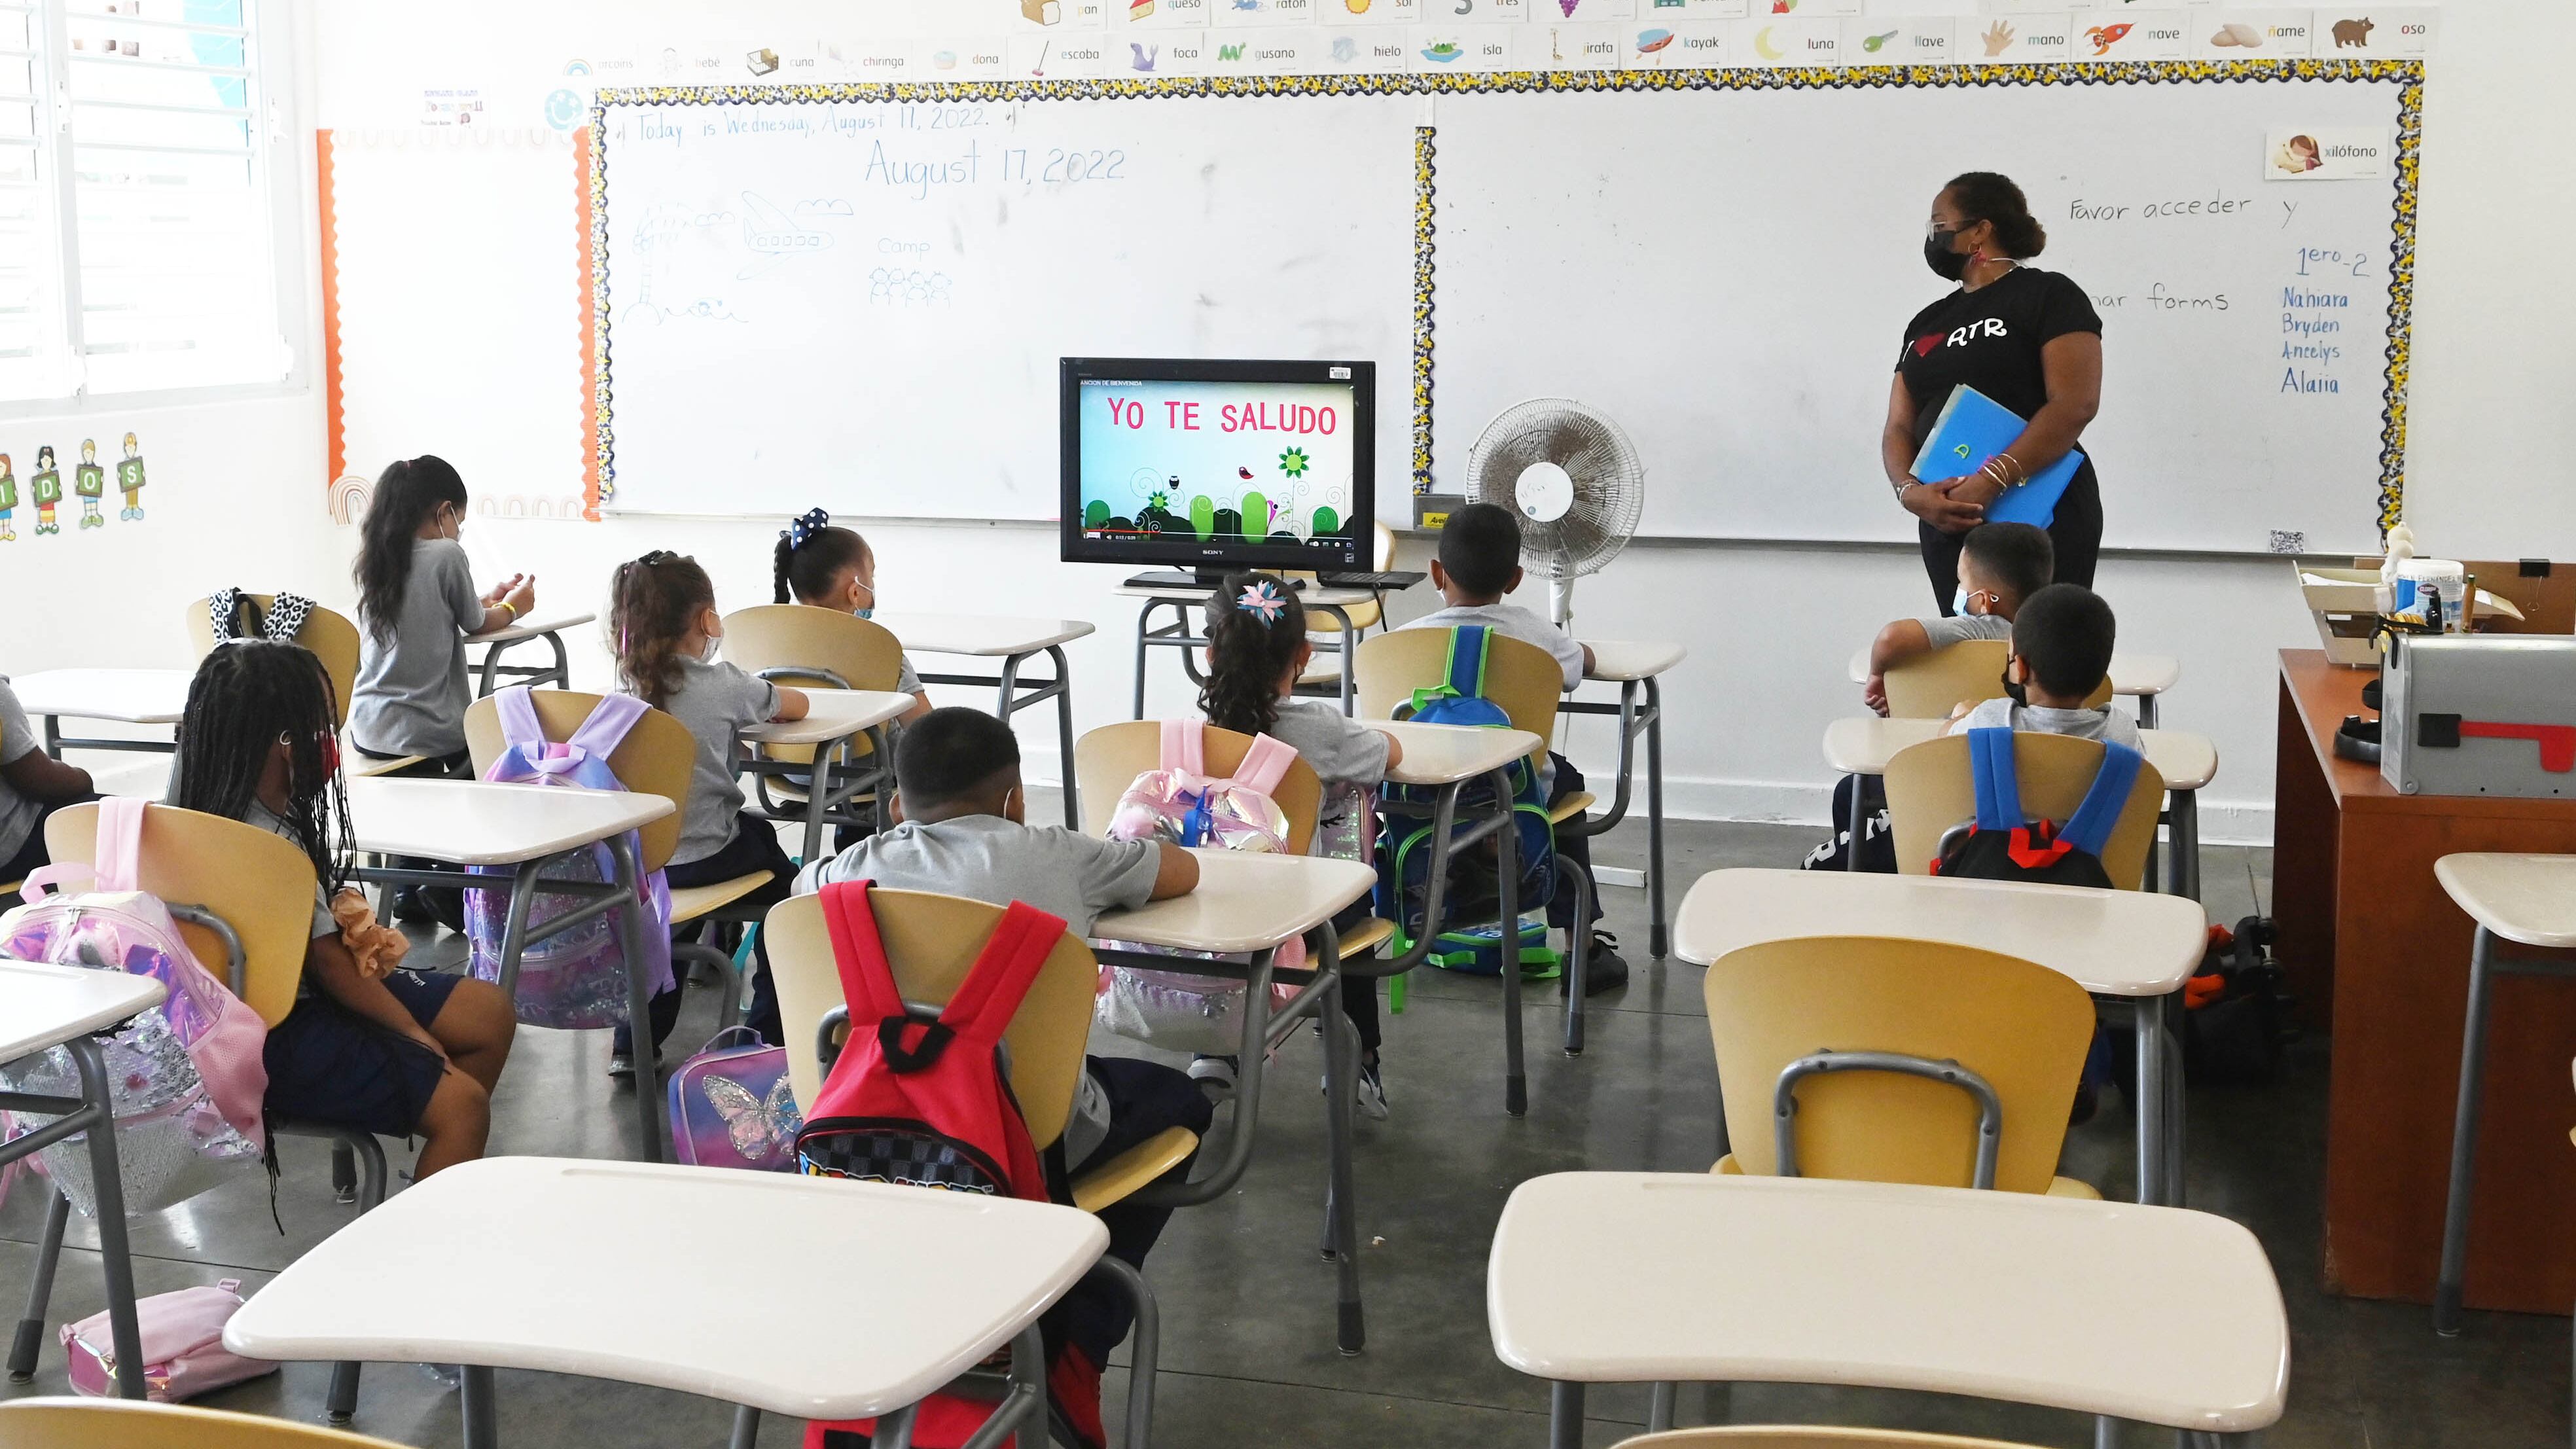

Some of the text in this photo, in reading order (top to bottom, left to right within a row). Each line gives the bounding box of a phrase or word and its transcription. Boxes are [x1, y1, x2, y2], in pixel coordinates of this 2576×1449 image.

[1078, 5, 1098, 17] pan
[1168, 0, 1201, 10] queso
[2148, 29, 2180, 40] nave
[2268, 25, 2305, 38] ñame
[2401, 24, 2425, 35] oso
[1684, 37, 1719, 52] kayak
[1807, 37, 1834, 50] luna
[1914, 35, 1944, 48] llave
[2028, 34, 2064, 45] mano
[1061, 48, 1100, 60] escoba
[1173, 46, 1198, 59] foca
[1255, 48, 1295, 62] gusano
[1374, 45, 1401, 57] hielo
[1482, 43, 1502, 55] isla
[1583, 41, 1613, 56] jirafa
[790, 58, 814, 67] cuna
[863, 55, 904, 69] chiringa
[973, 54, 998, 65] dona
[636, 112, 682, 147] Today
[703, 123, 715, 136] is
[822, 105, 884, 138] August
[2324, 145, 2377, 158] xilófono
[865, 139, 981, 200] August
[1043, 149, 1125, 183] 2022
[2070, 189, 2298, 229] Favor acceder y
[878, 238, 930, 262] Camp
[2147, 282, 2228, 310] forms
[2283, 287, 2348, 308] Nahiara
[2283, 312, 2339, 338] Bryden
[1108, 397, 1336, 435] YO TE SALUDO
